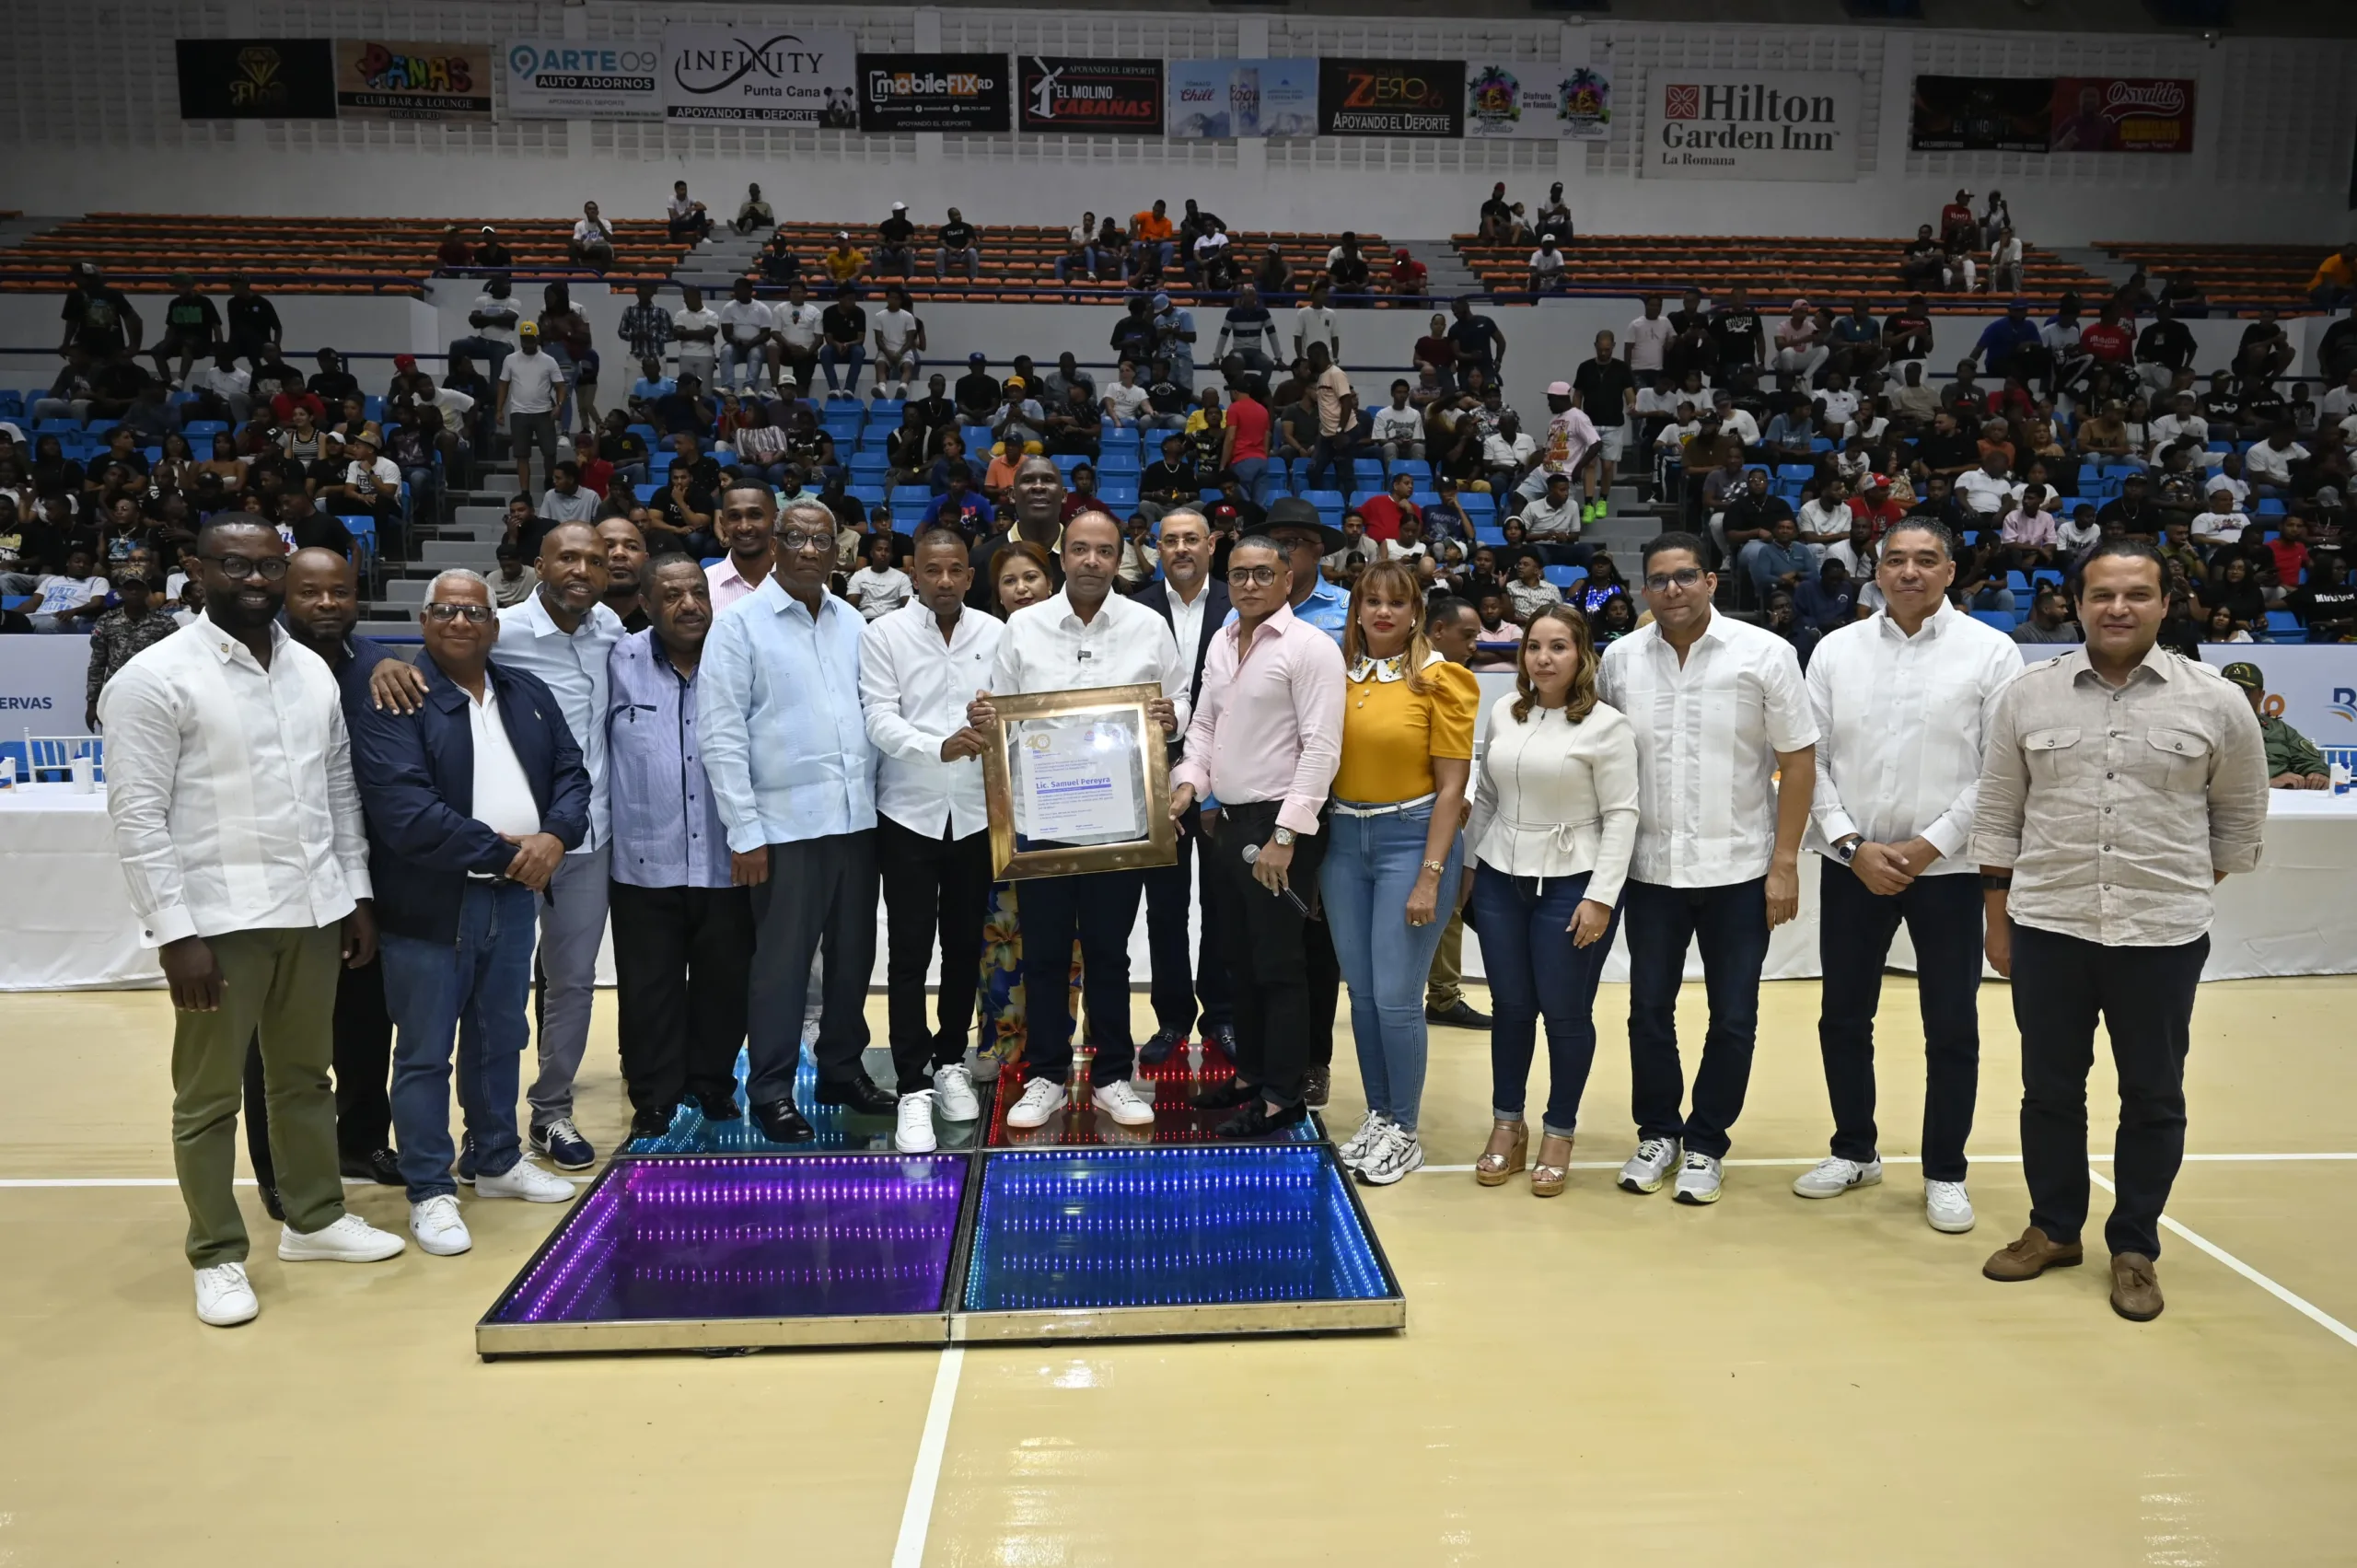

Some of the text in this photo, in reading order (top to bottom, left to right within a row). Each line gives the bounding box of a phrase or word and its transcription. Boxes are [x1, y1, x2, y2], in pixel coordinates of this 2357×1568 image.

[366, 42, 472, 92] PANAS
[541, 49, 657, 73] ARTE 09
[683, 49, 824, 74] INFINITY
[539, 75, 653, 89] AUTO ADORNOS
[744, 84, 820, 98] Punta Cana
[1057, 85, 1113, 99] EL MOLINO
[1180, 88, 1215, 101] Chill
[355, 95, 387, 106] CLUB
[389, 96, 412, 107] BAR
[426, 98, 473, 109] LOUNGE
[1701, 84, 1836, 122] Hilton
[676, 106, 742, 119] APOYANDO
[744, 108, 761, 119] EL
[761, 109, 819, 121] DEPORTE
[1663, 122, 1774, 149] Garden
[1662, 152, 1736, 167] La Romana
[1051, 778, 1079, 788] Samuel
[1081, 776, 1110, 785] Pereyra
